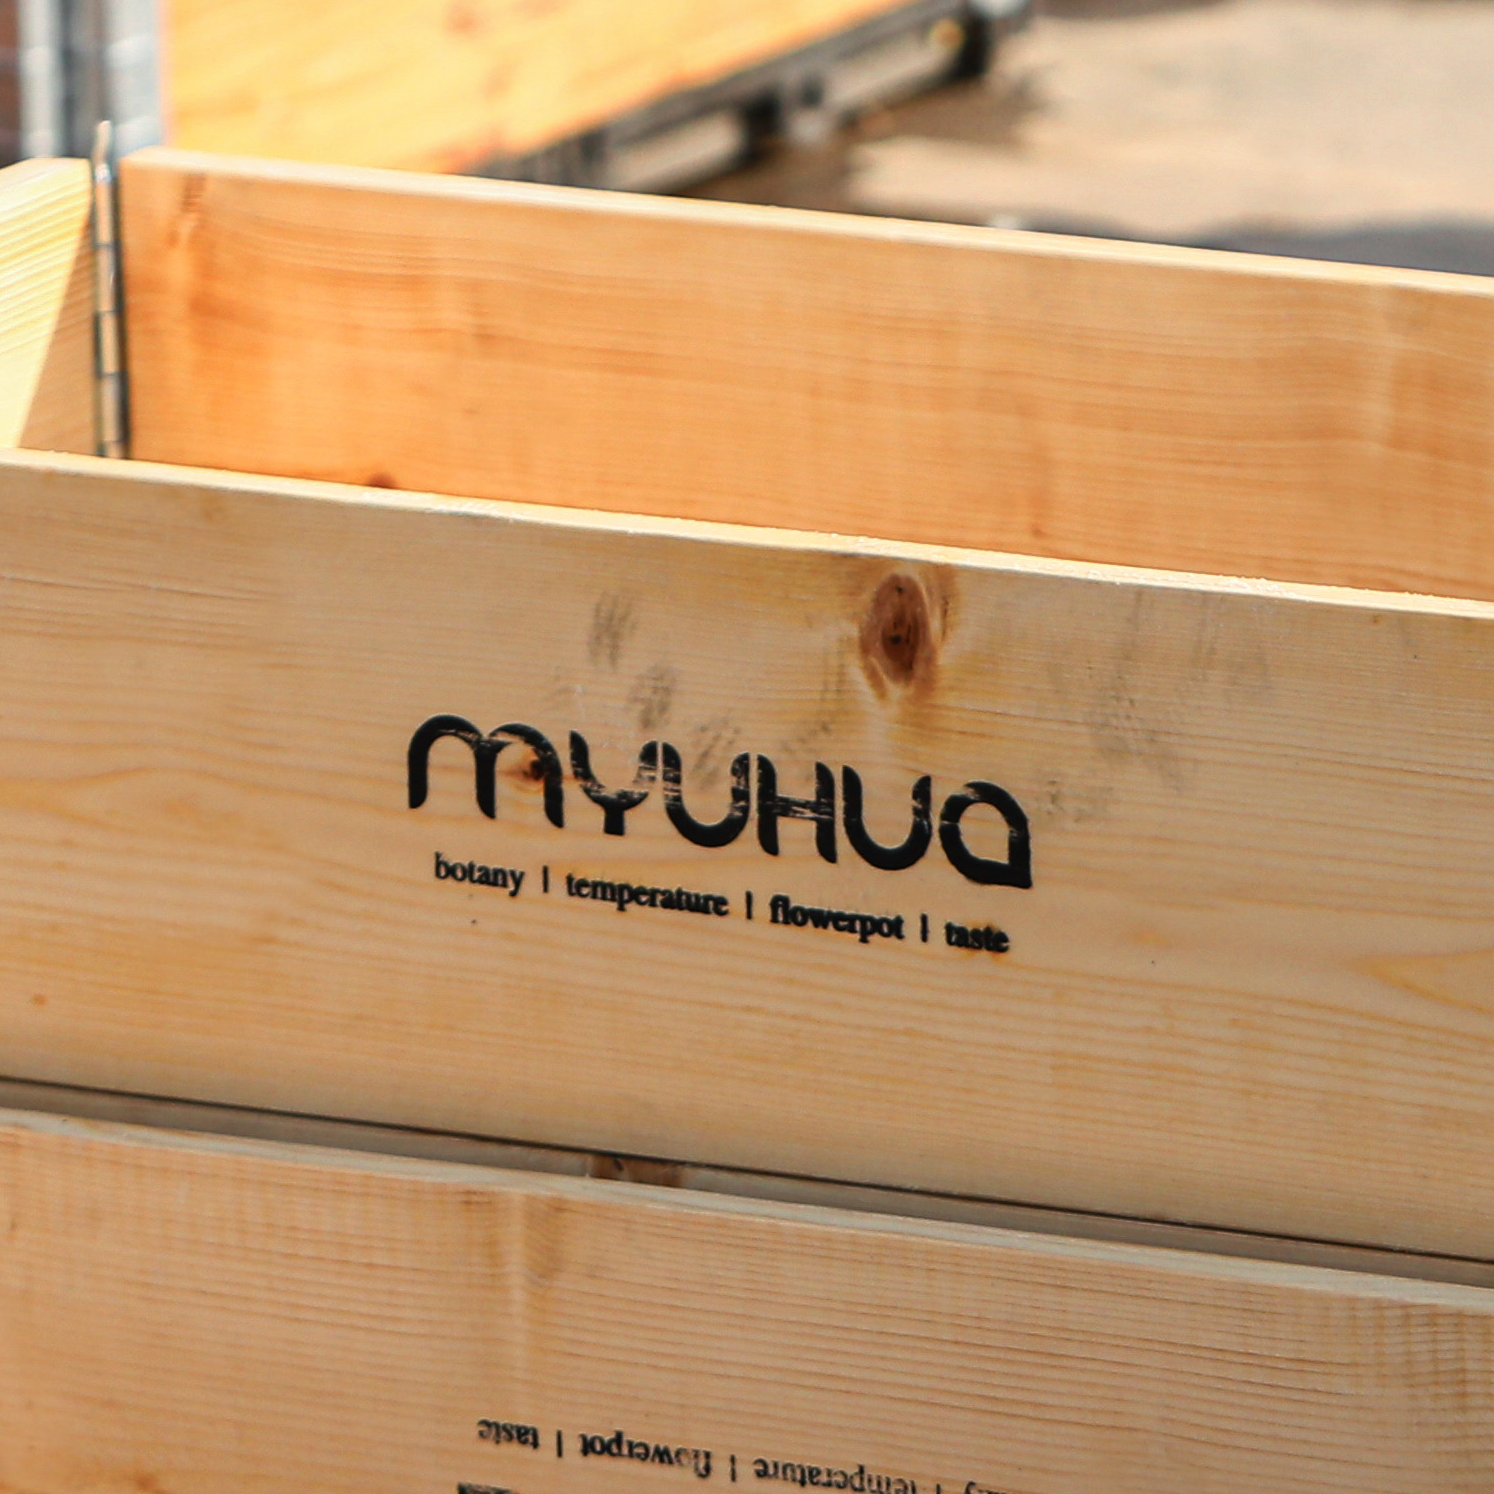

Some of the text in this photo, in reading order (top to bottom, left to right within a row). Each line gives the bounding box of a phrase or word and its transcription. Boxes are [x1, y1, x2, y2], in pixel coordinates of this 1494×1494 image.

[434, 852, 1010, 954] botany temperature flowerpot taste
[476, 1418, 540, 1450] taste
[580, 1432, 713, 1480] flowerpot
